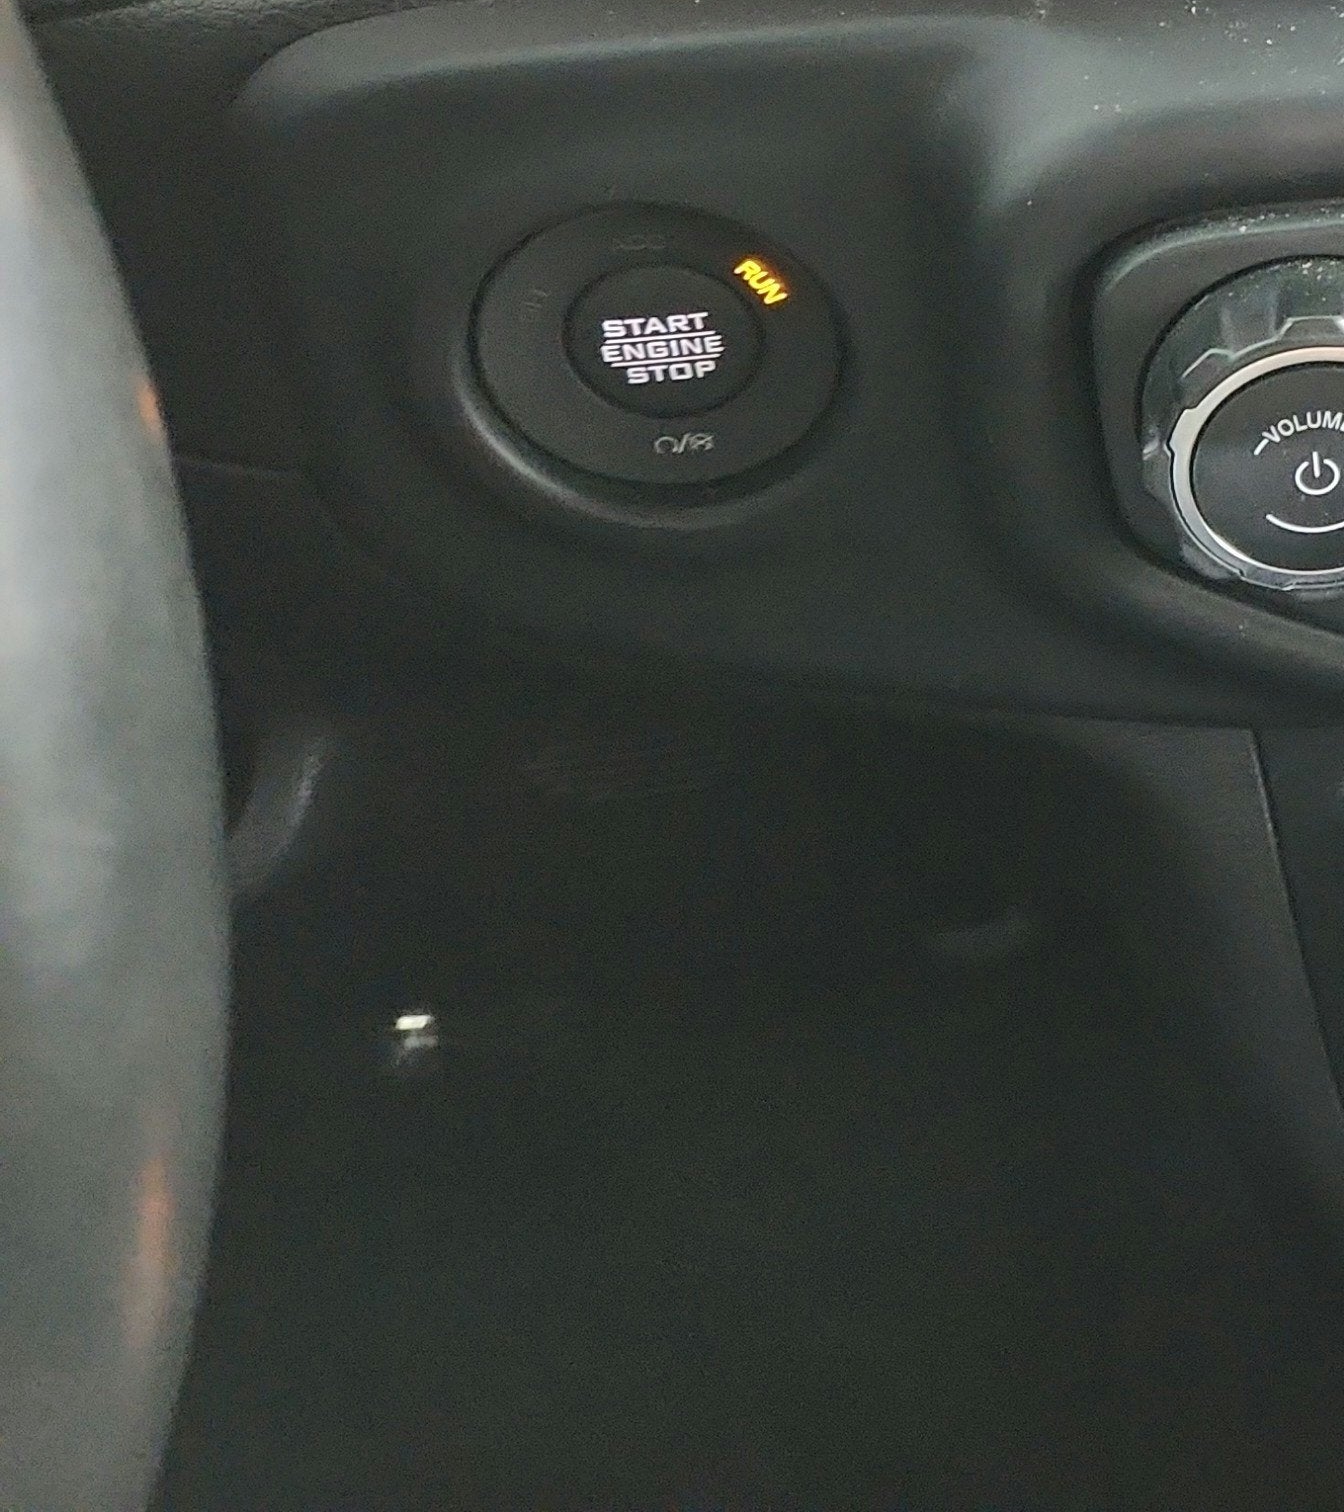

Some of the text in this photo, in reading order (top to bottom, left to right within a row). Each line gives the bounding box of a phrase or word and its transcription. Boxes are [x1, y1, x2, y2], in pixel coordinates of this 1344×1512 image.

[733, 258, 788, 305] RUN
[601, 311, 710, 338] START
[600, 334, 726, 363] ENGINE
[626, 359, 717, 384] STOP
